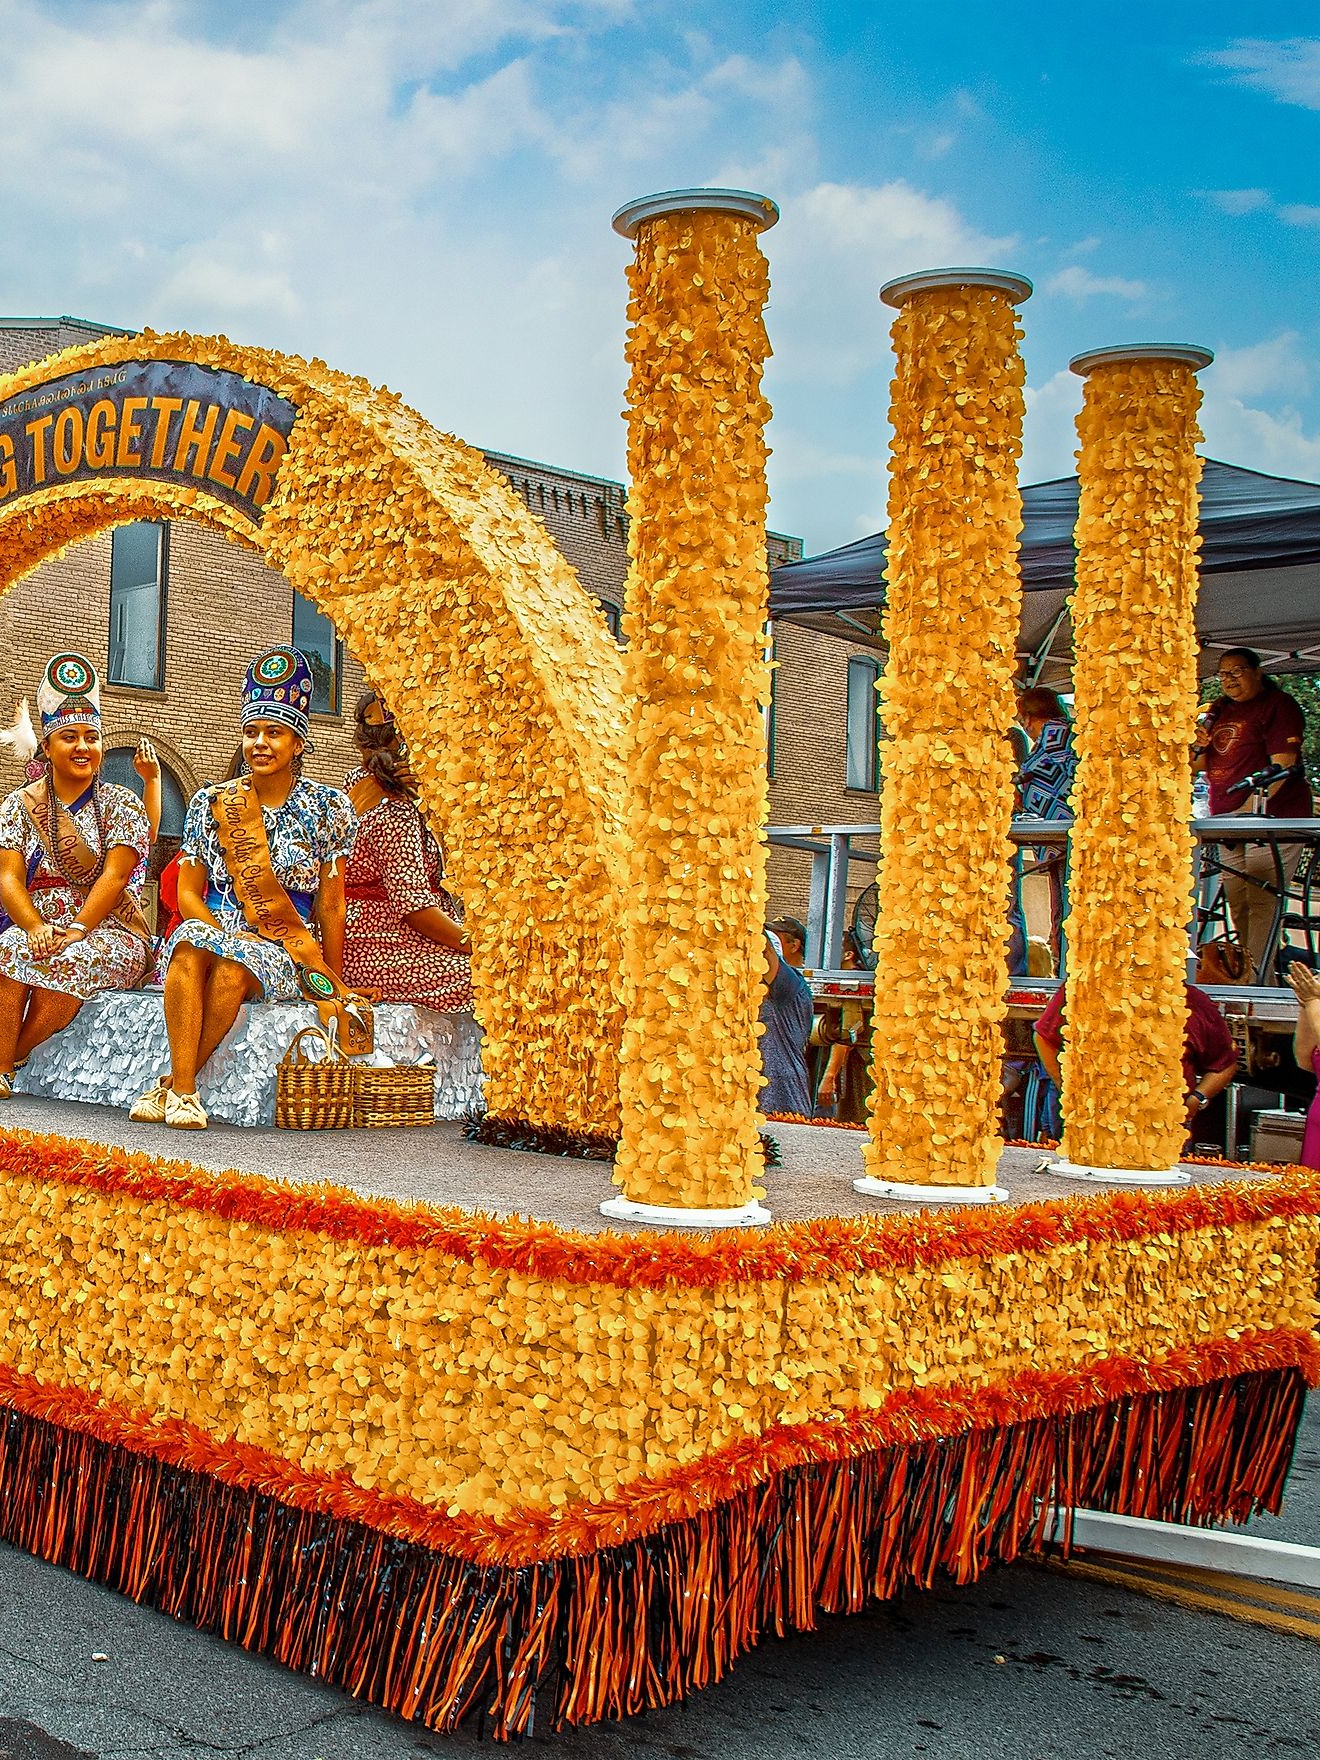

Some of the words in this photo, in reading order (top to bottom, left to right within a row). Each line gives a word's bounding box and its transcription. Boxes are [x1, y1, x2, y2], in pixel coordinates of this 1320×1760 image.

[26, 397, 289, 508] TOGETHER
[223, 795, 247, 826] Teen
[230, 829, 256, 864] Miss
[241, 865, 273, 921] Cherokee
[264, 918, 304, 949] 2018
